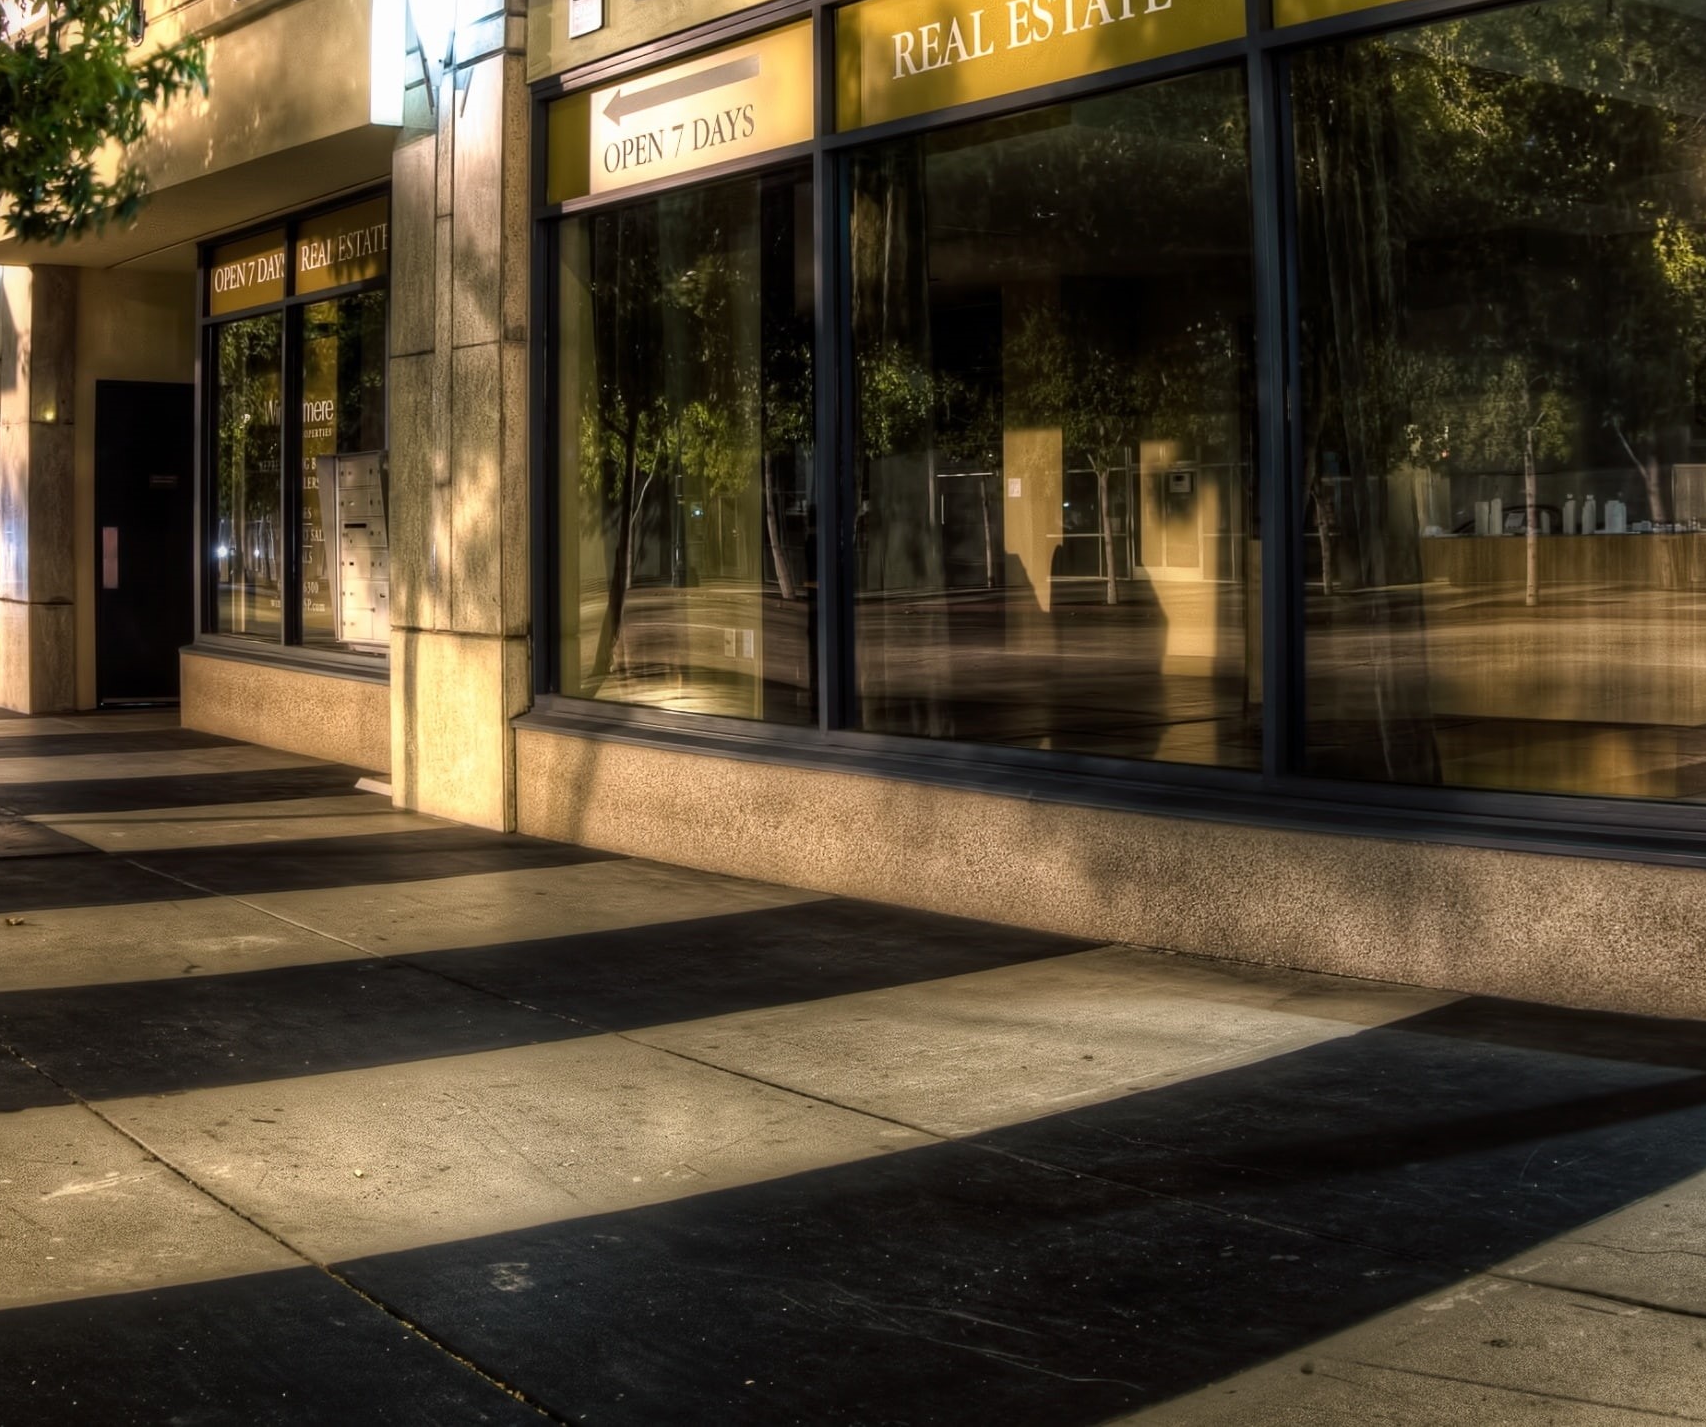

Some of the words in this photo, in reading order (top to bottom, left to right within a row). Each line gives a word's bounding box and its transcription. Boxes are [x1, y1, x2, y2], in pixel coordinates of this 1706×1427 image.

[891, 9, 995, 80] REAL
[603, 128, 665, 174] OPEN
[671, 123, 685, 159] 7
[692, 103, 756, 151] DAYS
[214, 260, 247, 293] OPEN
[247, 260, 256, 287] 7
[300, 238, 334, 272] REAL
[338, 223, 388, 263] ESTATE
